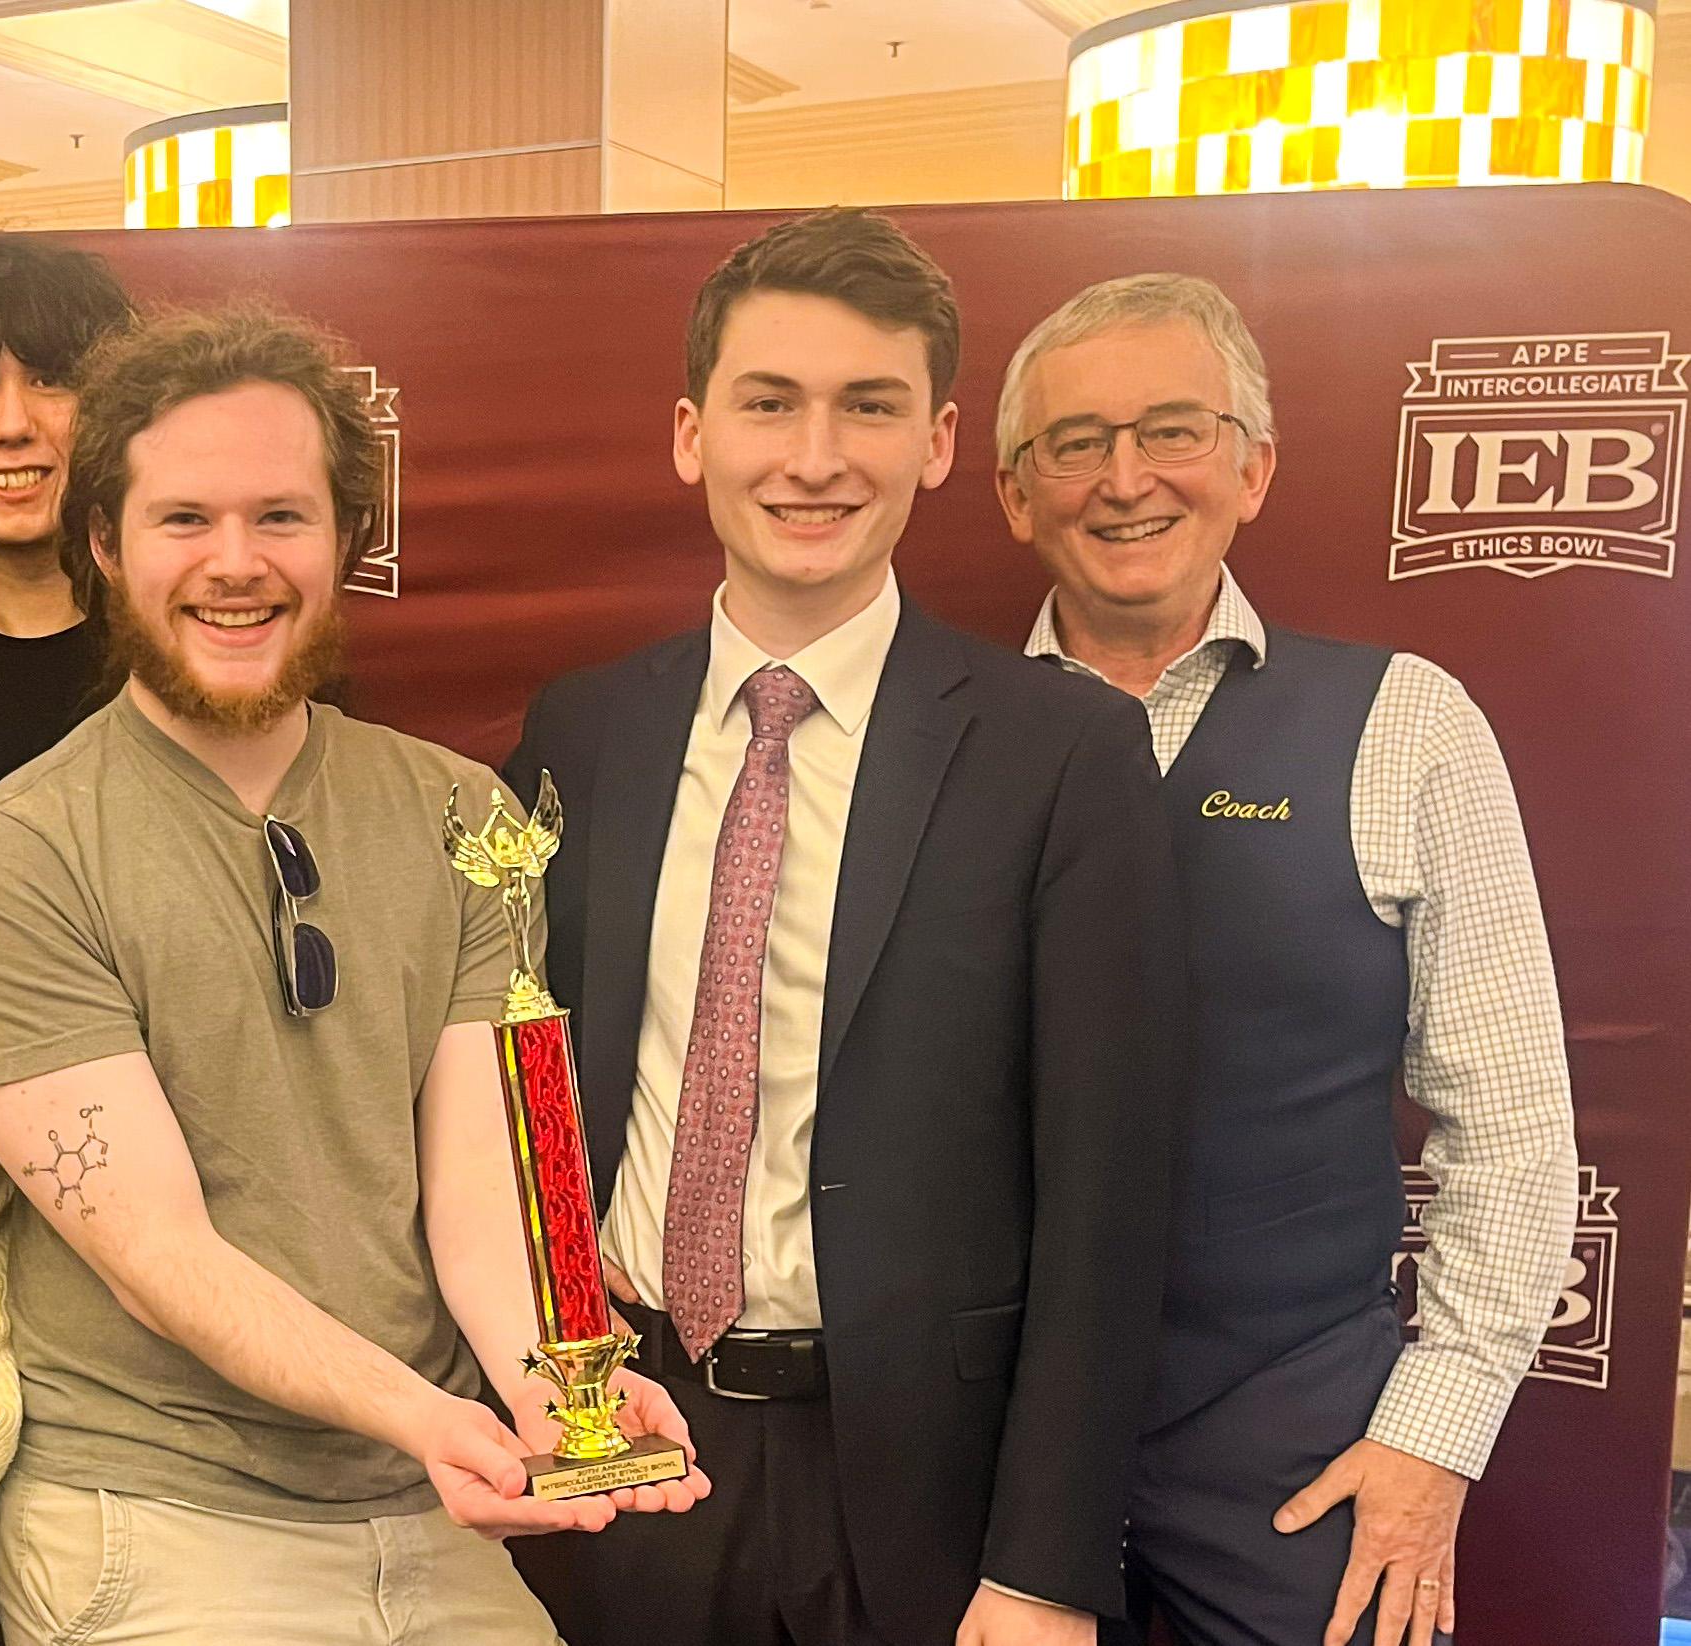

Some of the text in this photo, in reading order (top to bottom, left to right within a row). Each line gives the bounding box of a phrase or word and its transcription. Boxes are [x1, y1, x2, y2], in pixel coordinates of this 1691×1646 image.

[1512, 343, 1589, 365] APPE
[1446, 374, 1648, 397] INTERCOLLEGIATE
[1416, 429, 1660, 514] IEB
[1452, 536, 1607, 560] ETHICS BOWL
[1201, 790, 1292, 820] Coach
